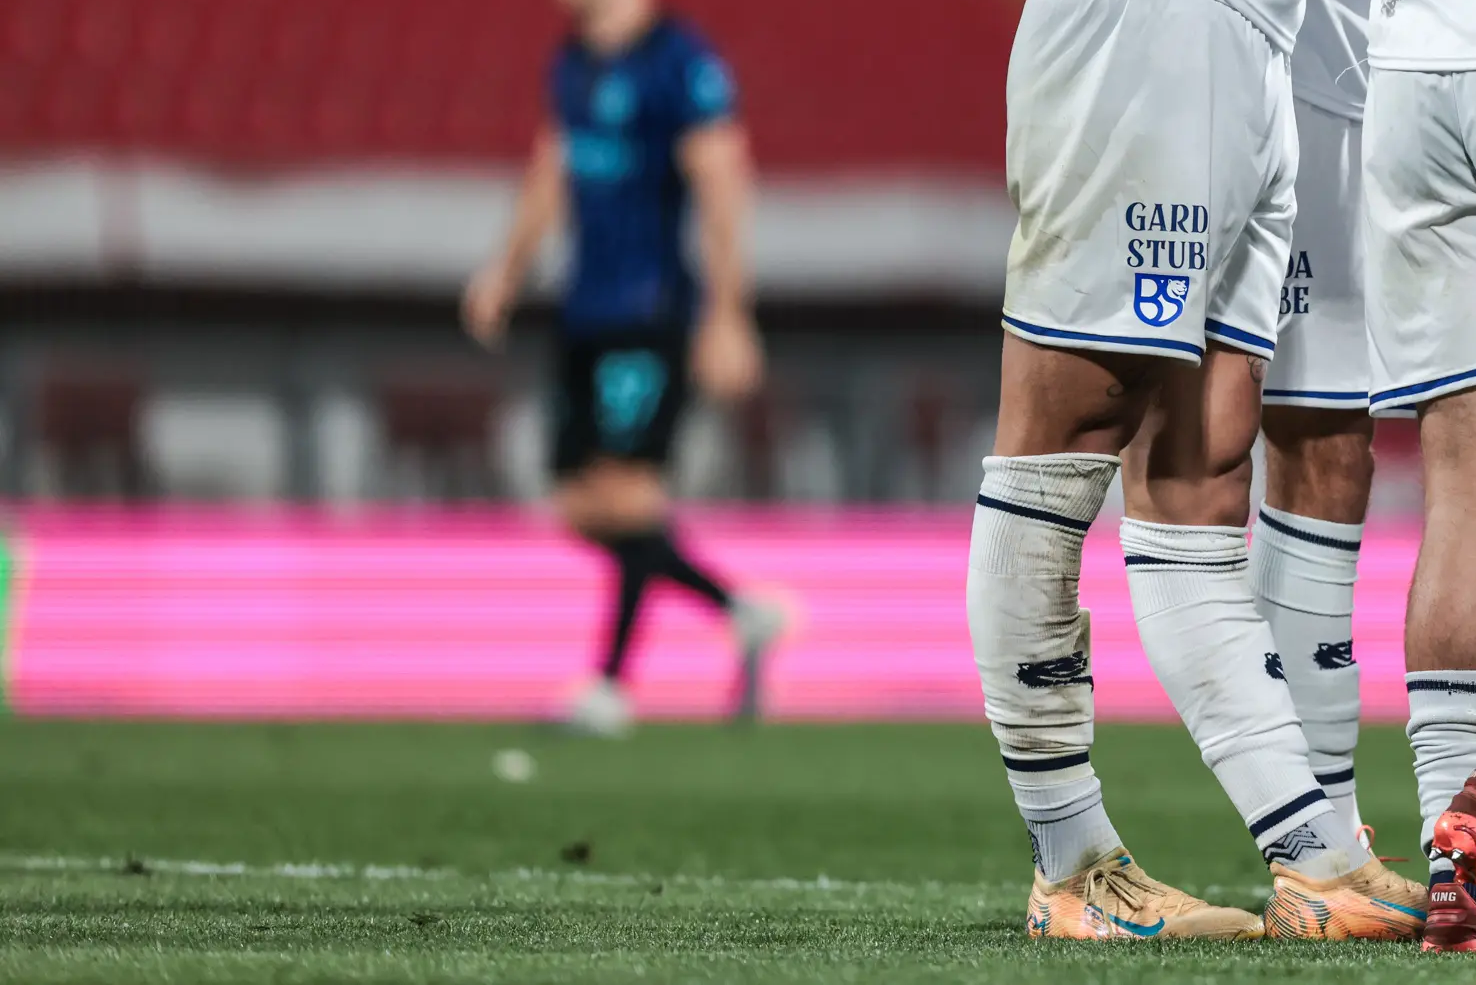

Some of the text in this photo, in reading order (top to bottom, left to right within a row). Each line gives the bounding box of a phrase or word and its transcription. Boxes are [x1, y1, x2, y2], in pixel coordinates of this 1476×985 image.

[1125, 201, 1209, 234] GARD
[1126, 238, 1209, 271] STUB
[1431, 891, 1457, 903] KING
